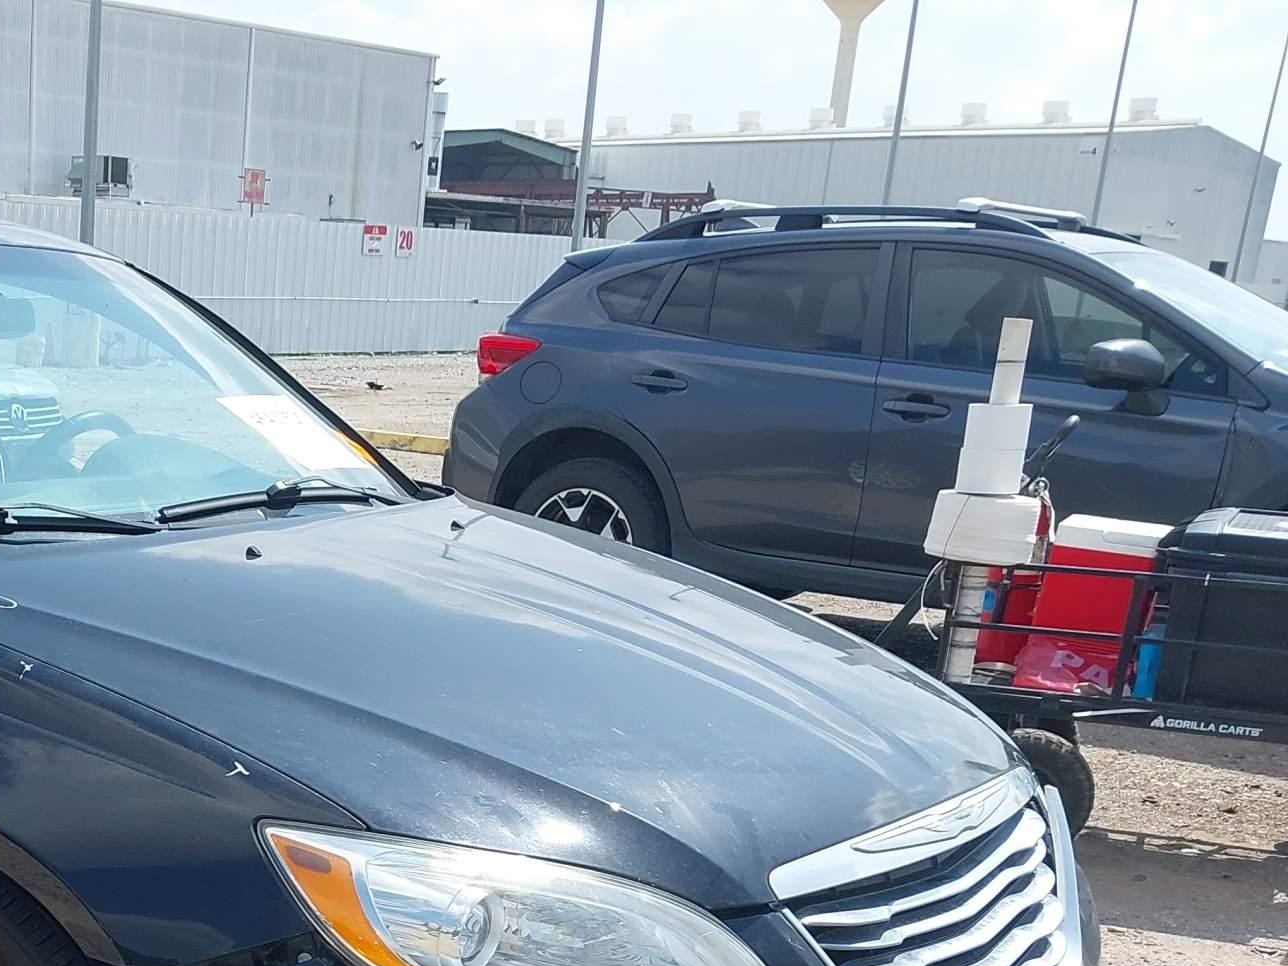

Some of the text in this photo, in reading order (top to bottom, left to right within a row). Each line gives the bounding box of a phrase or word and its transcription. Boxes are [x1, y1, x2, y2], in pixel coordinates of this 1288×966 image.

[398, 230, 414, 250] 20
[1166, 718, 1260, 737] GORILLA CARTS
